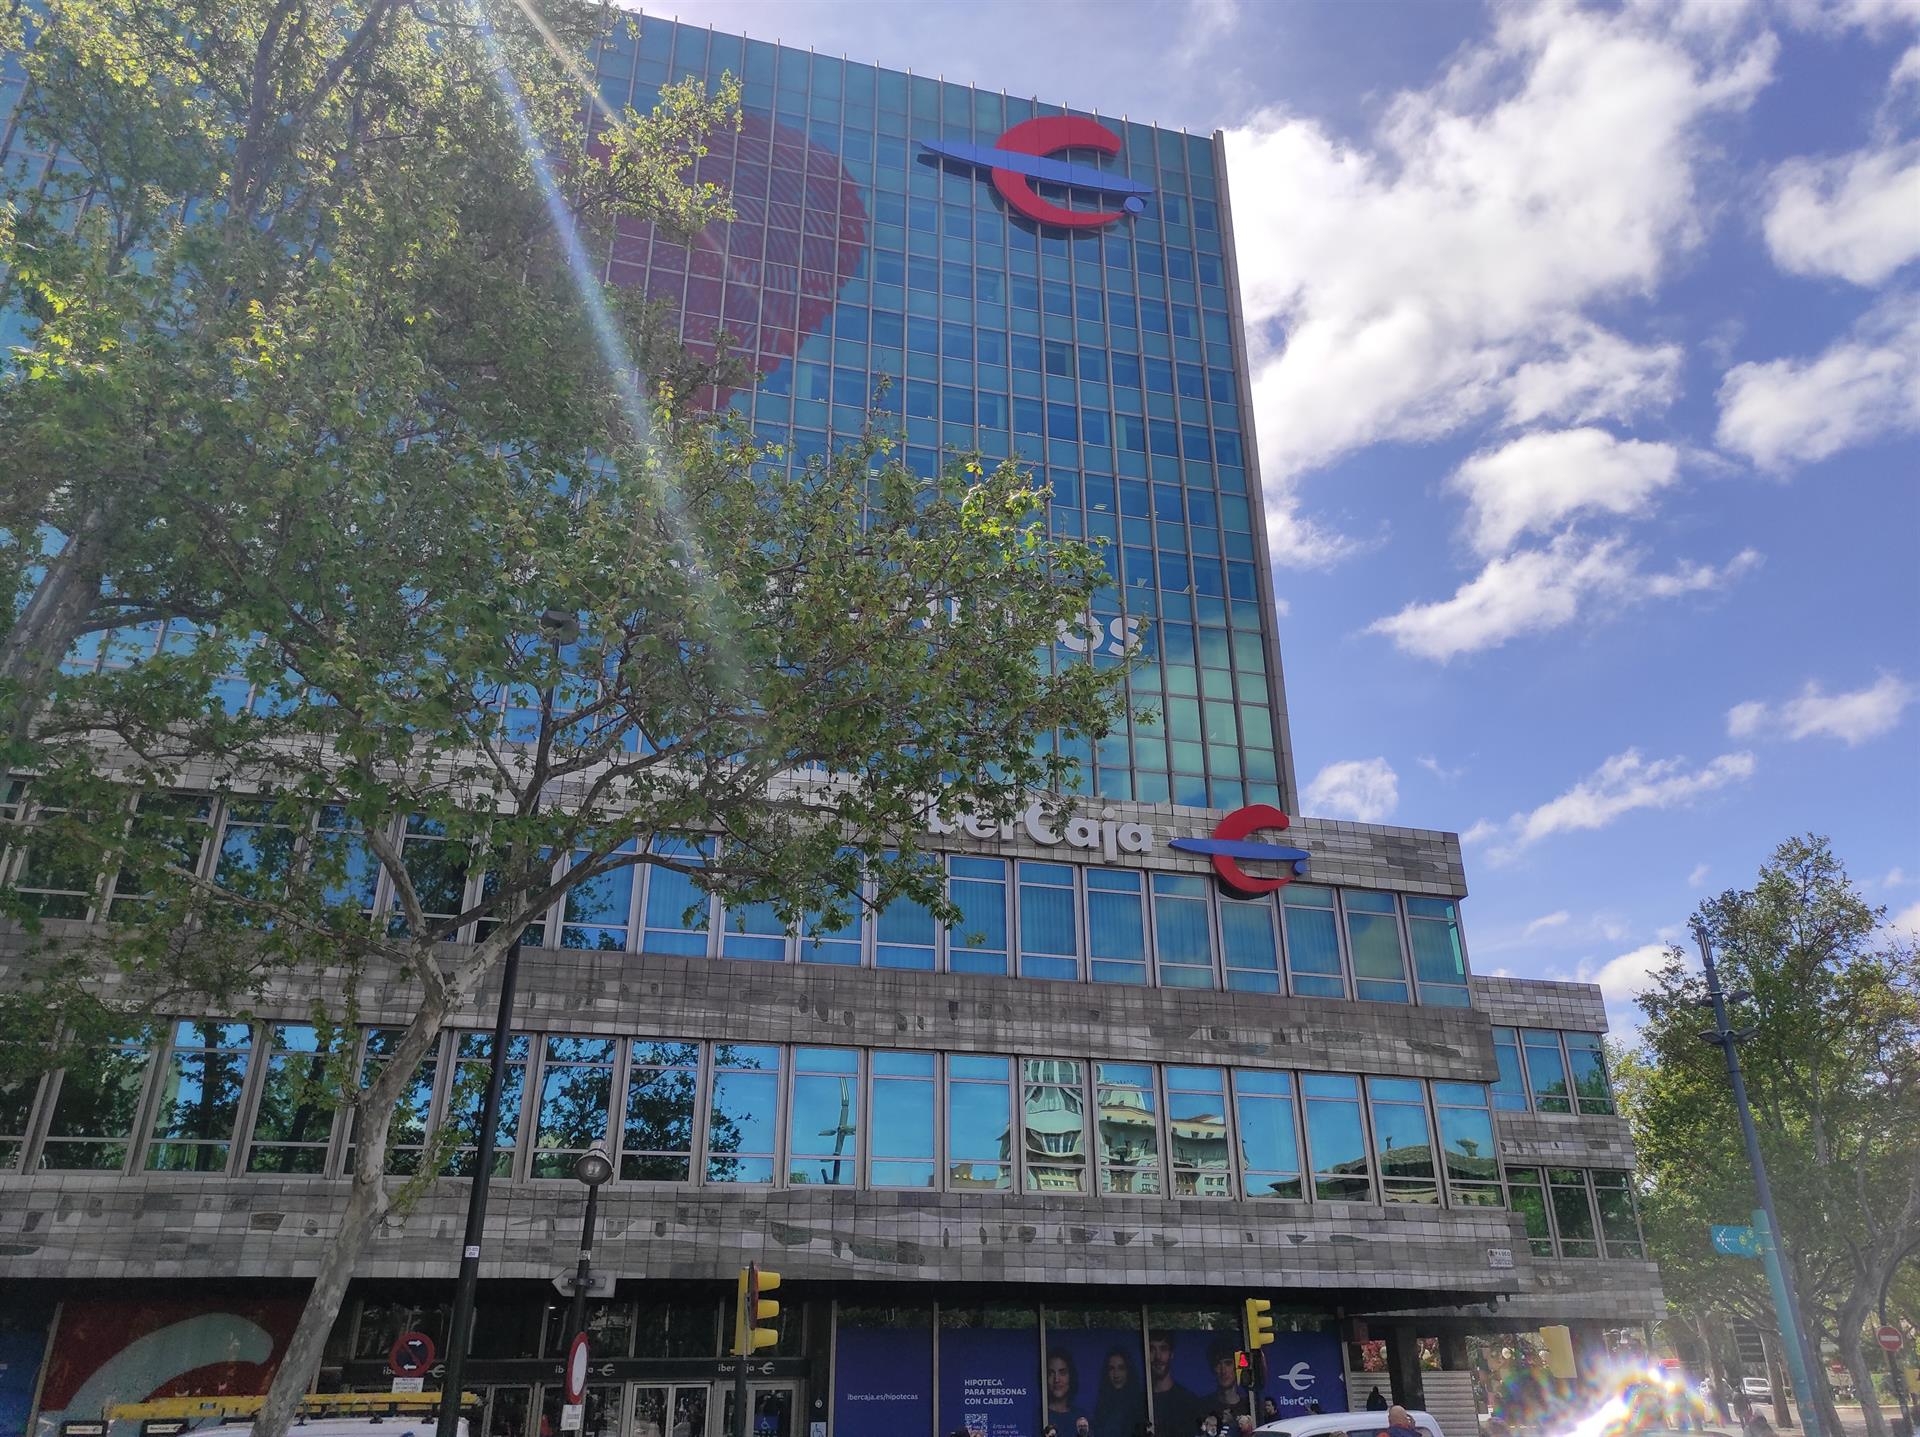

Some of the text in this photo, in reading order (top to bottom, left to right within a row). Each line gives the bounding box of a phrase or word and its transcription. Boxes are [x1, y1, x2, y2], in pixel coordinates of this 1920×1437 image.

[718, 1363, 755, 1374] iberja
[964, 1388, 1027, 1396] PARA PERSONAS
[964, 1397, 1014, 1405] CON CABEZA
